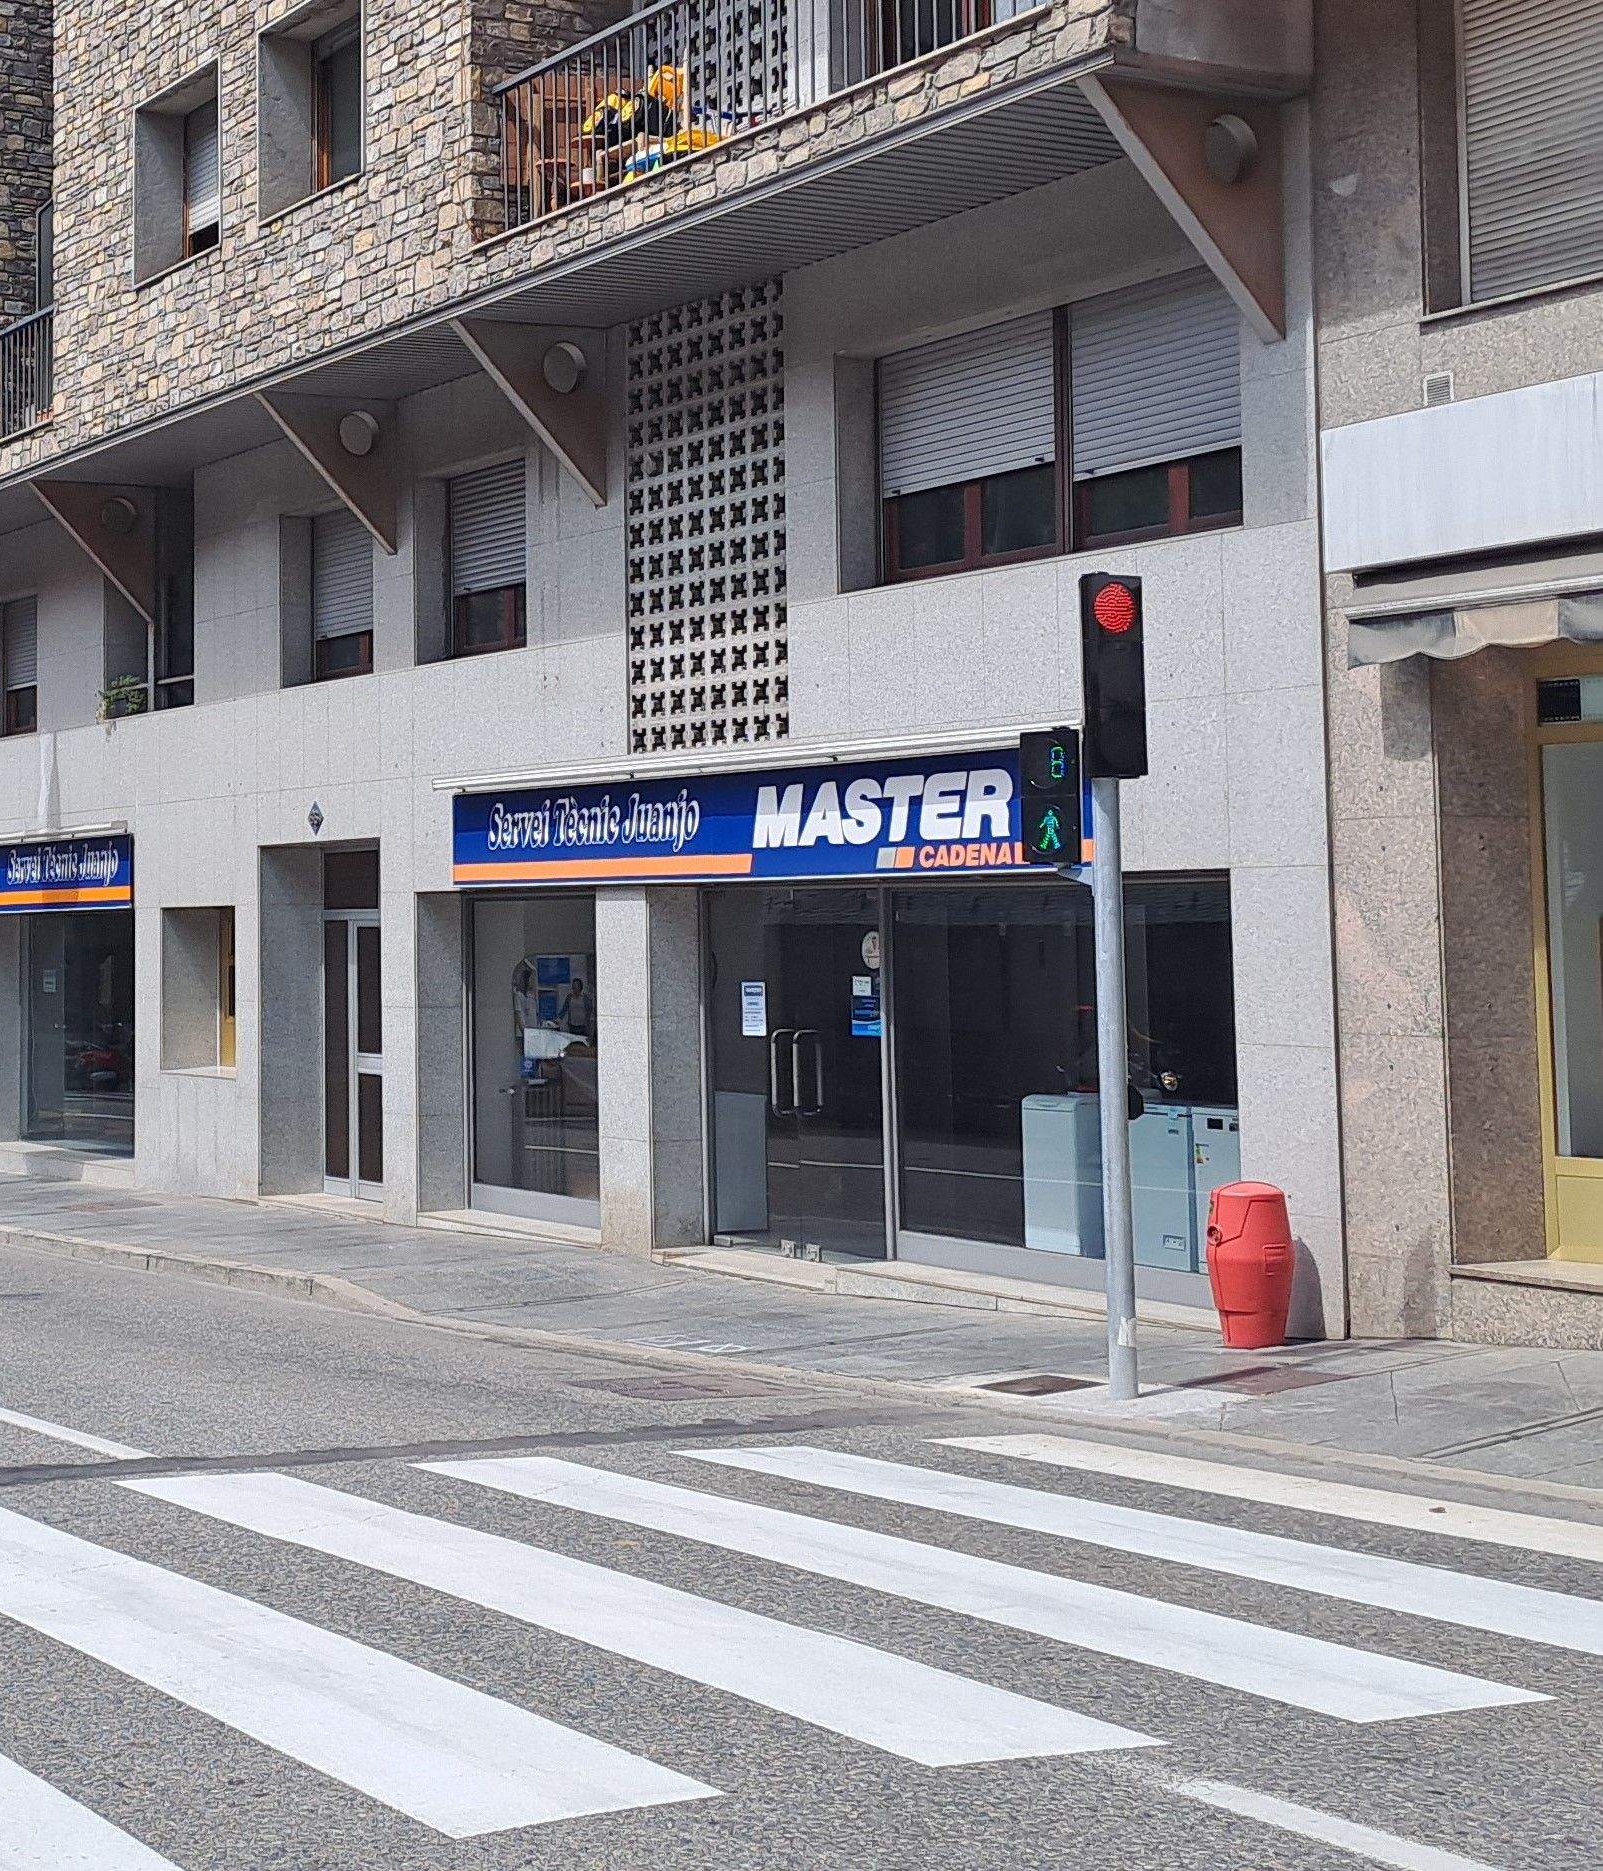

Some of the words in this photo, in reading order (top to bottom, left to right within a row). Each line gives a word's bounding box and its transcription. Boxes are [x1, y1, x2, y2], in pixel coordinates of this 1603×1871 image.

[487, 798, 551, 851] Servei
[553, 795, 620, 847] Tècnic
[621, 788, 700, 852] Juanjo
[752, 768, 1013, 849] MASTER
[919, 842, 1015, 868] CADENA
